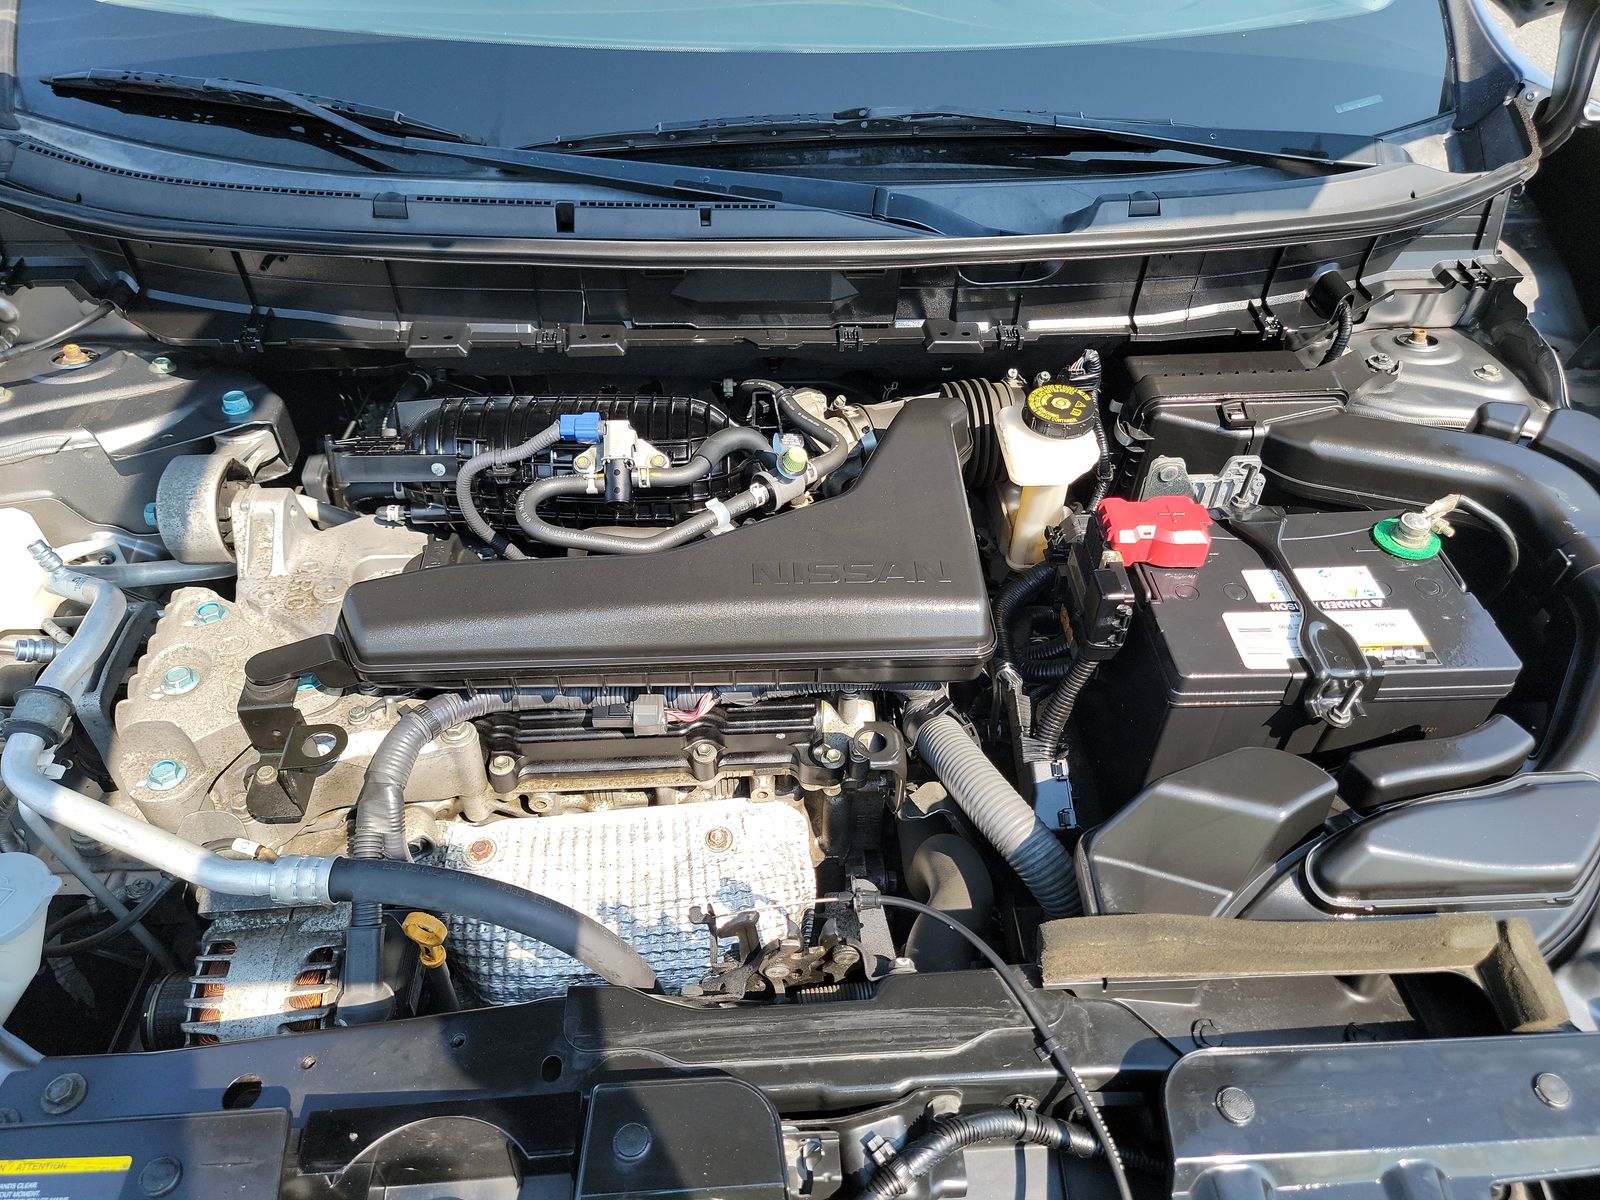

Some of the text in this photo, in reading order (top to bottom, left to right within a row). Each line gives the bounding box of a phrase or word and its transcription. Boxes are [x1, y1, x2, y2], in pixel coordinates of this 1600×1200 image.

[751, 559, 953, 585] NISSAN
[1321, 600, 1370, 609] DANGER
[16, 1161, 67, 1170] ATTENTION
